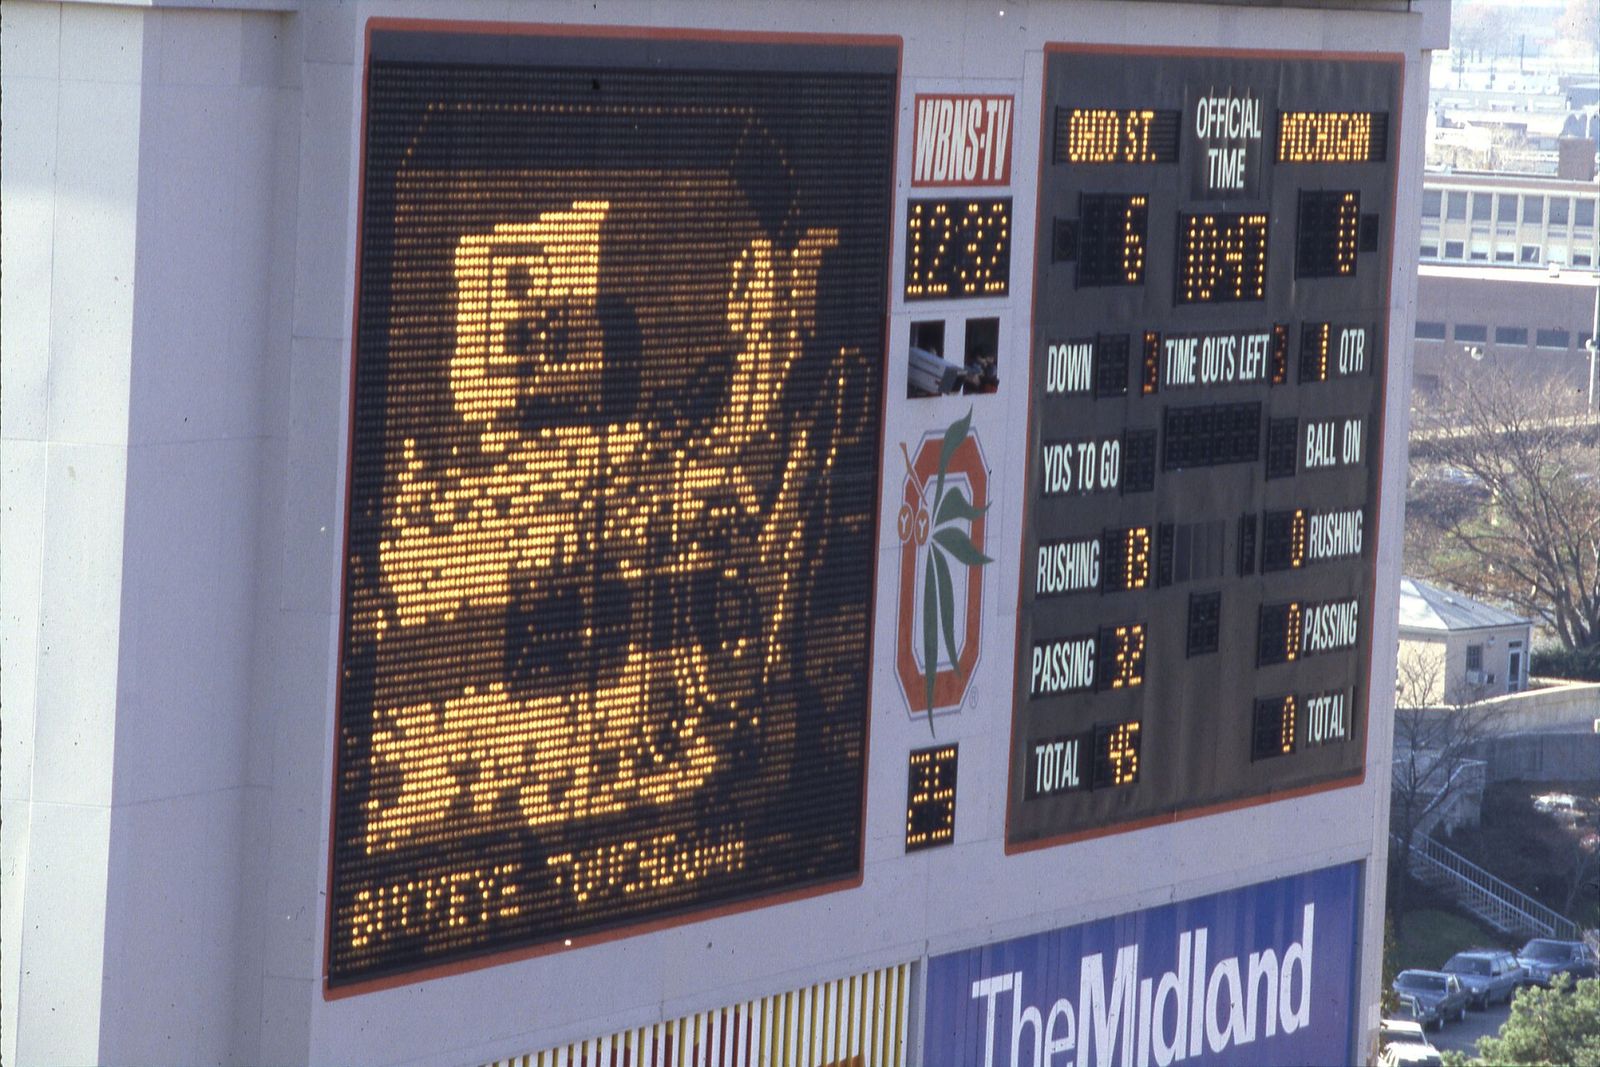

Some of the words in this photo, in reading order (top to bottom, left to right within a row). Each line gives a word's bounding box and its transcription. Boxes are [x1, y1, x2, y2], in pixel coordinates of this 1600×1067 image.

[914, 98, 1012, 182] WBNS-TV
[1068, 109, 1120, 161] OHIO
[1195, 97, 1262, 139] OFFICIAL
[1279, 111, 1373, 162] MICHIGAN
[1207, 147, 1247, 190] TIME
[1123, 195, 1146, 281] 6
[1337, 193, 1357, 274] 0
[1047, 342, 1093, 393] DOWN
[1165, 339, 1199, 386] TIME
[1201, 336, 1236, 383] OUTS
[1239, 333, 1270, 380] LEFT
[1339, 329, 1365, 375] QTR
[1043, 441, 1072, 494] YDS
[1077, 440, 1096, 491] TO
[1099, 438, 1120, 489] GO
[1305, 421, 1337, 468] BALL
[1342, 419, 1363, 464] ON
[1291, 509, 1305, 568] 0
[1309, 510, 1363, 559] RUSHING
[1035, 540, 1100, 594] RUSHING
[1287, 602, 1301, 661] 0
[1303, 601, 1359, 651] PASSING
[1030, 639, 1095, 694] PASSING
[1282, 695, 1296, 754] 0
[1307, 694, 1345, 743] TOTAL
[1035, 740, 1080, 794] TOTAL
